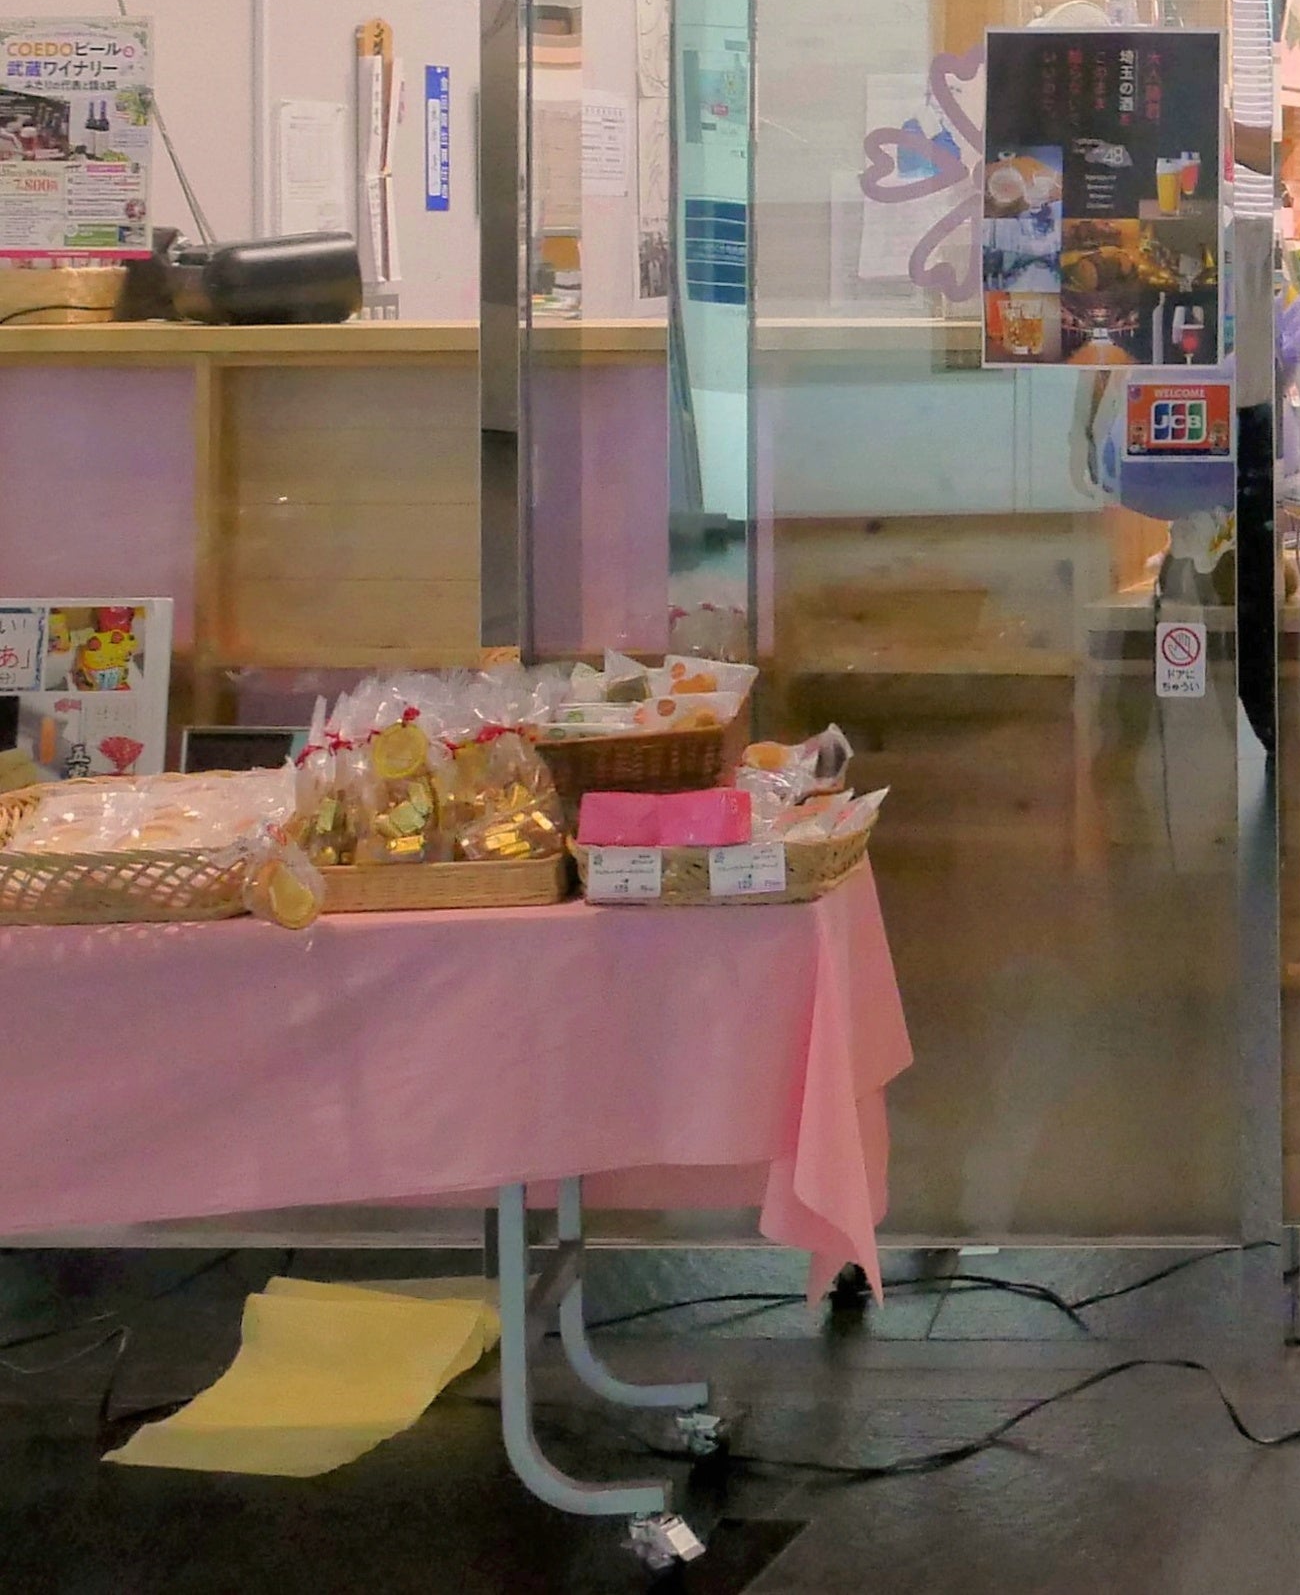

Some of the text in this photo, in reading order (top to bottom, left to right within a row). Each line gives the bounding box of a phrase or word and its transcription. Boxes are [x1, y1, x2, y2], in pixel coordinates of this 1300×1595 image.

[7, 60, 118, 77] 武蔵ワイナリー
[1154, 388, 1205, 398] WELCOME
[1153, 415, 1202, 429] JCB
[1167, 669, 1195, 679] ドアに
